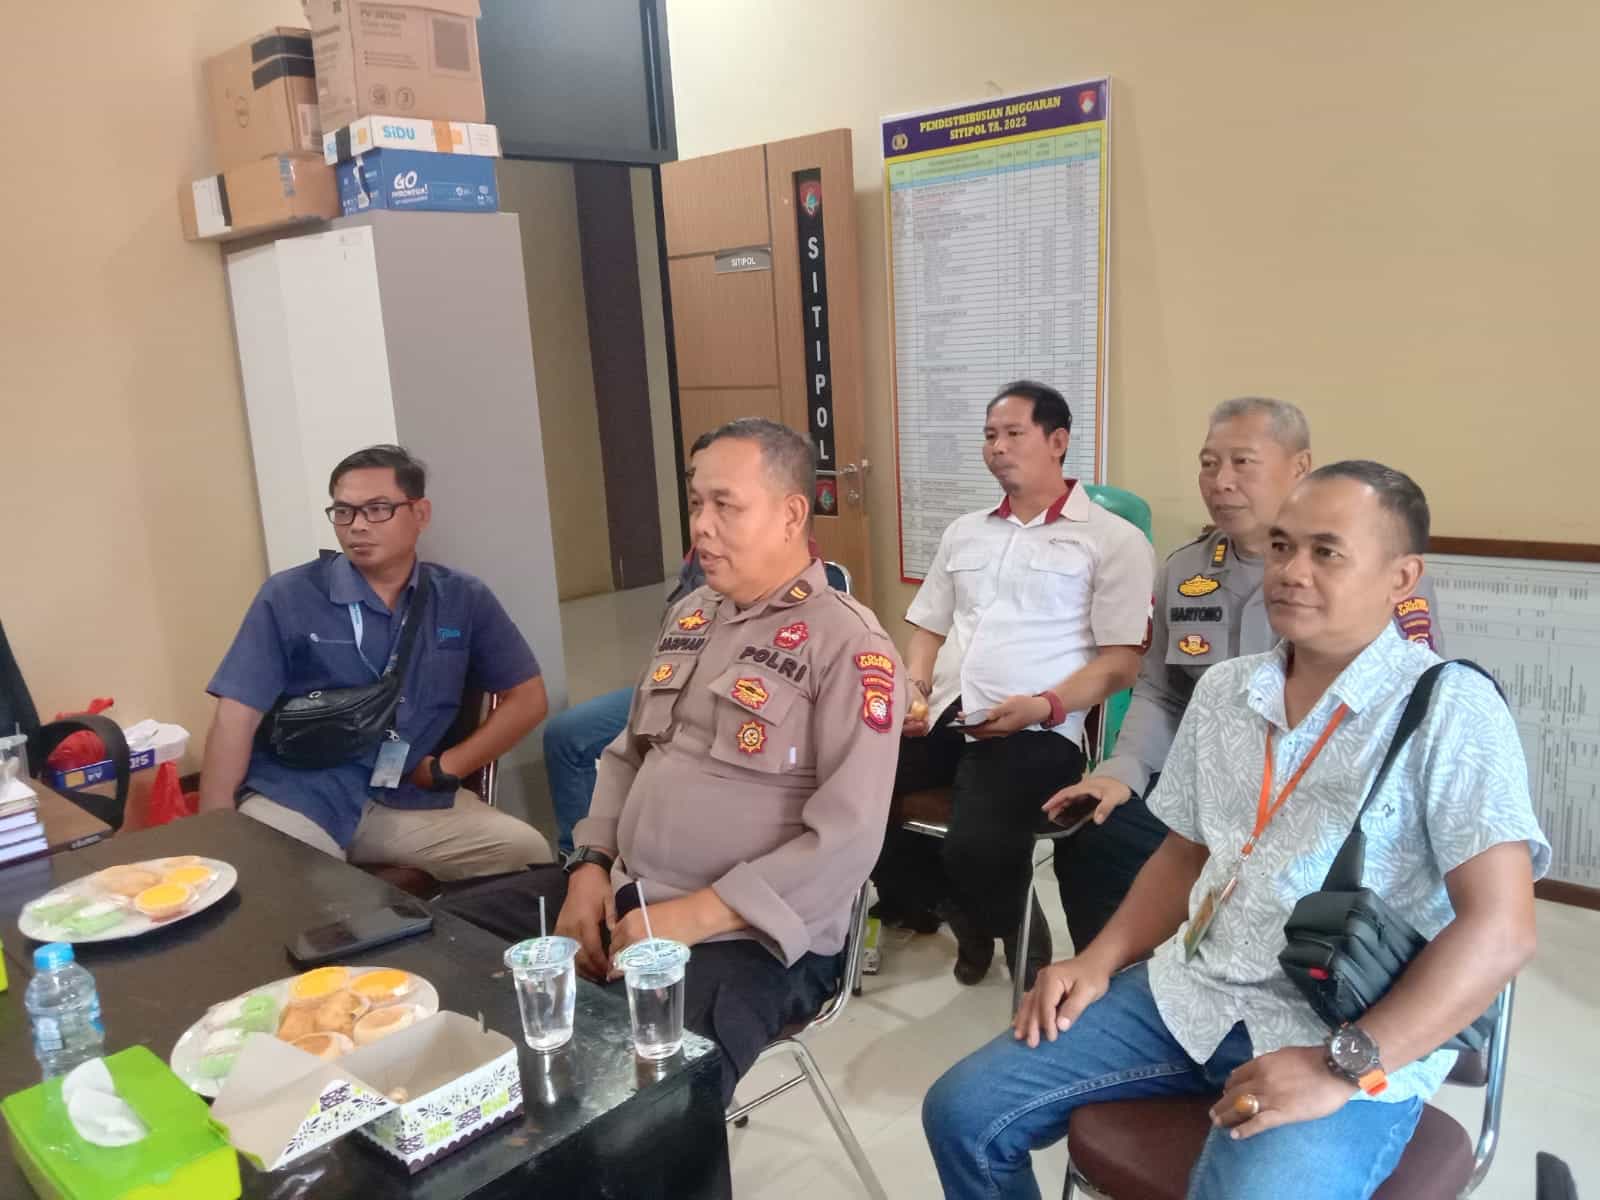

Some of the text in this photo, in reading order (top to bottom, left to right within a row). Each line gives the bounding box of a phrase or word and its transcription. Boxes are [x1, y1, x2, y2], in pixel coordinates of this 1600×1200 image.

[920, 96, 1061, 133] PENDISTRIBUSIAN ANGGARAN
[1004, 116, 1027, 130] 2022
[393, 170, 418, 190] GO
[731, 256, 756, 268] SITIPOL
[807, 236, 829, 461] SITIPOL
[739, 646, 808, 683] POLRI
